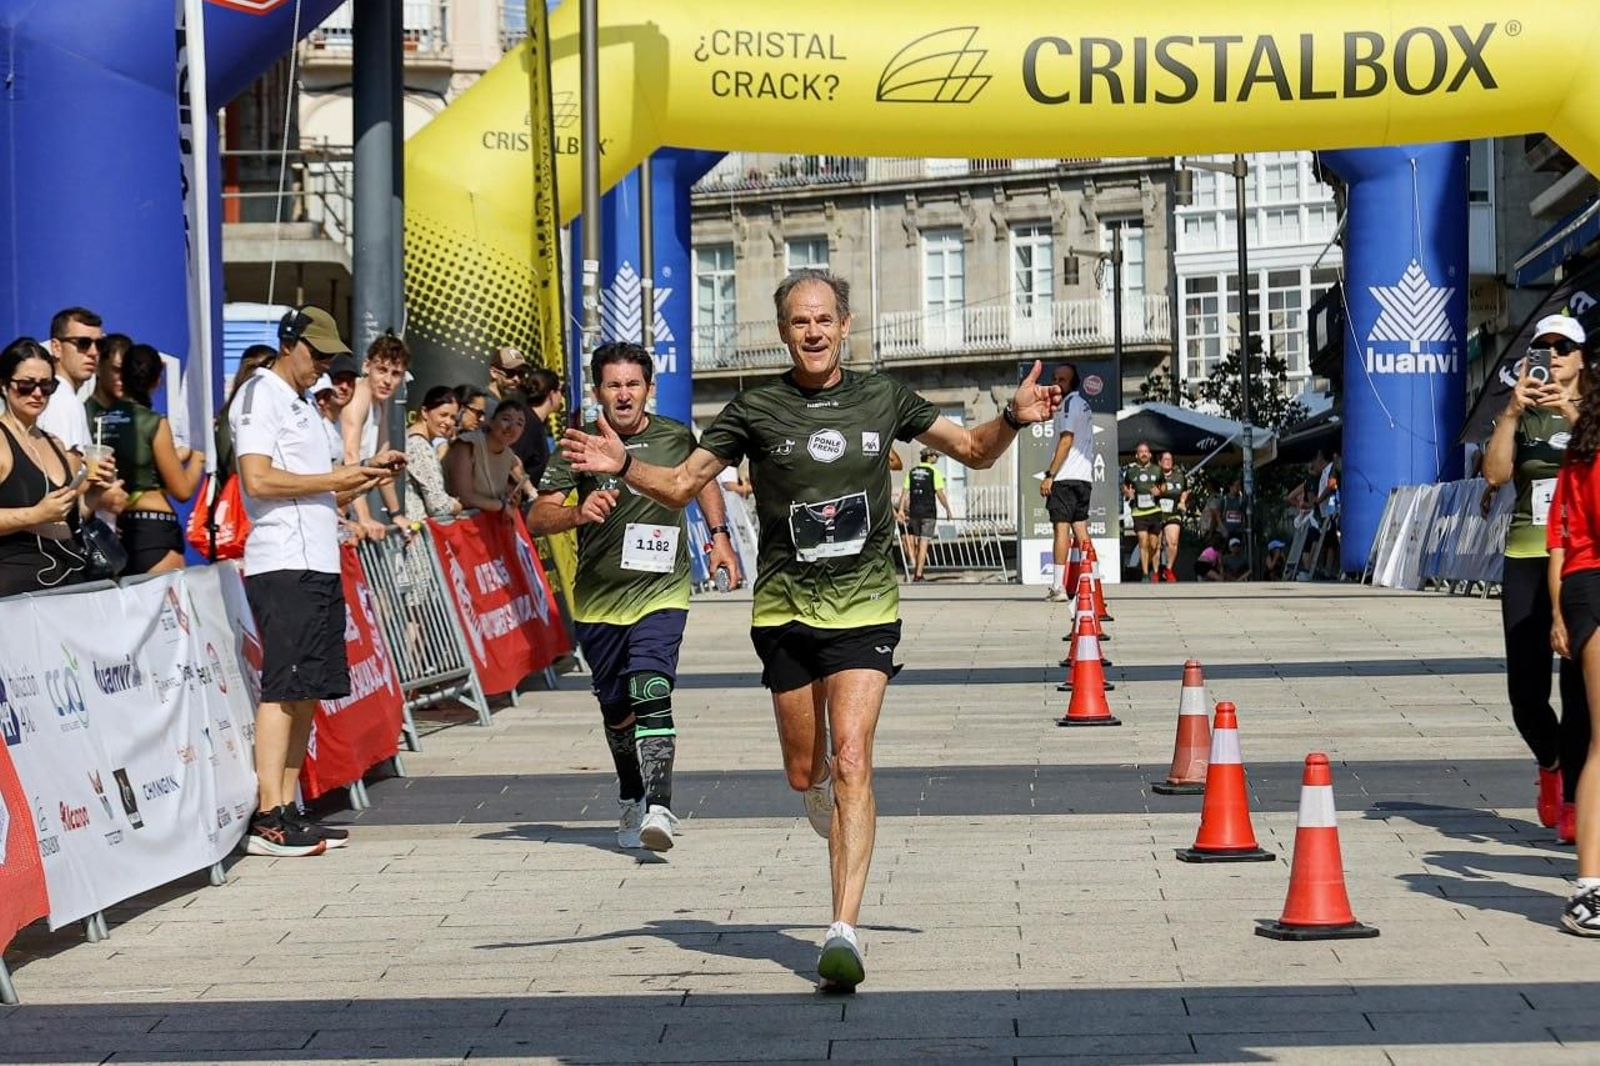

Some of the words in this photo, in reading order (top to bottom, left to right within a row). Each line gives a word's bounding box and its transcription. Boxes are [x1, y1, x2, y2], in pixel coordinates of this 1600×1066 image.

[693, 29, 847, 61] ¿CRISTAL
[711, 69, 840, 101] CRACK?
[1366, 347, 1458, 374] luanvi
[812, 443, 840, 454] FRENO
[814, 437, 842, 448] PONLE
[636, 539, 670, 552] 1182
